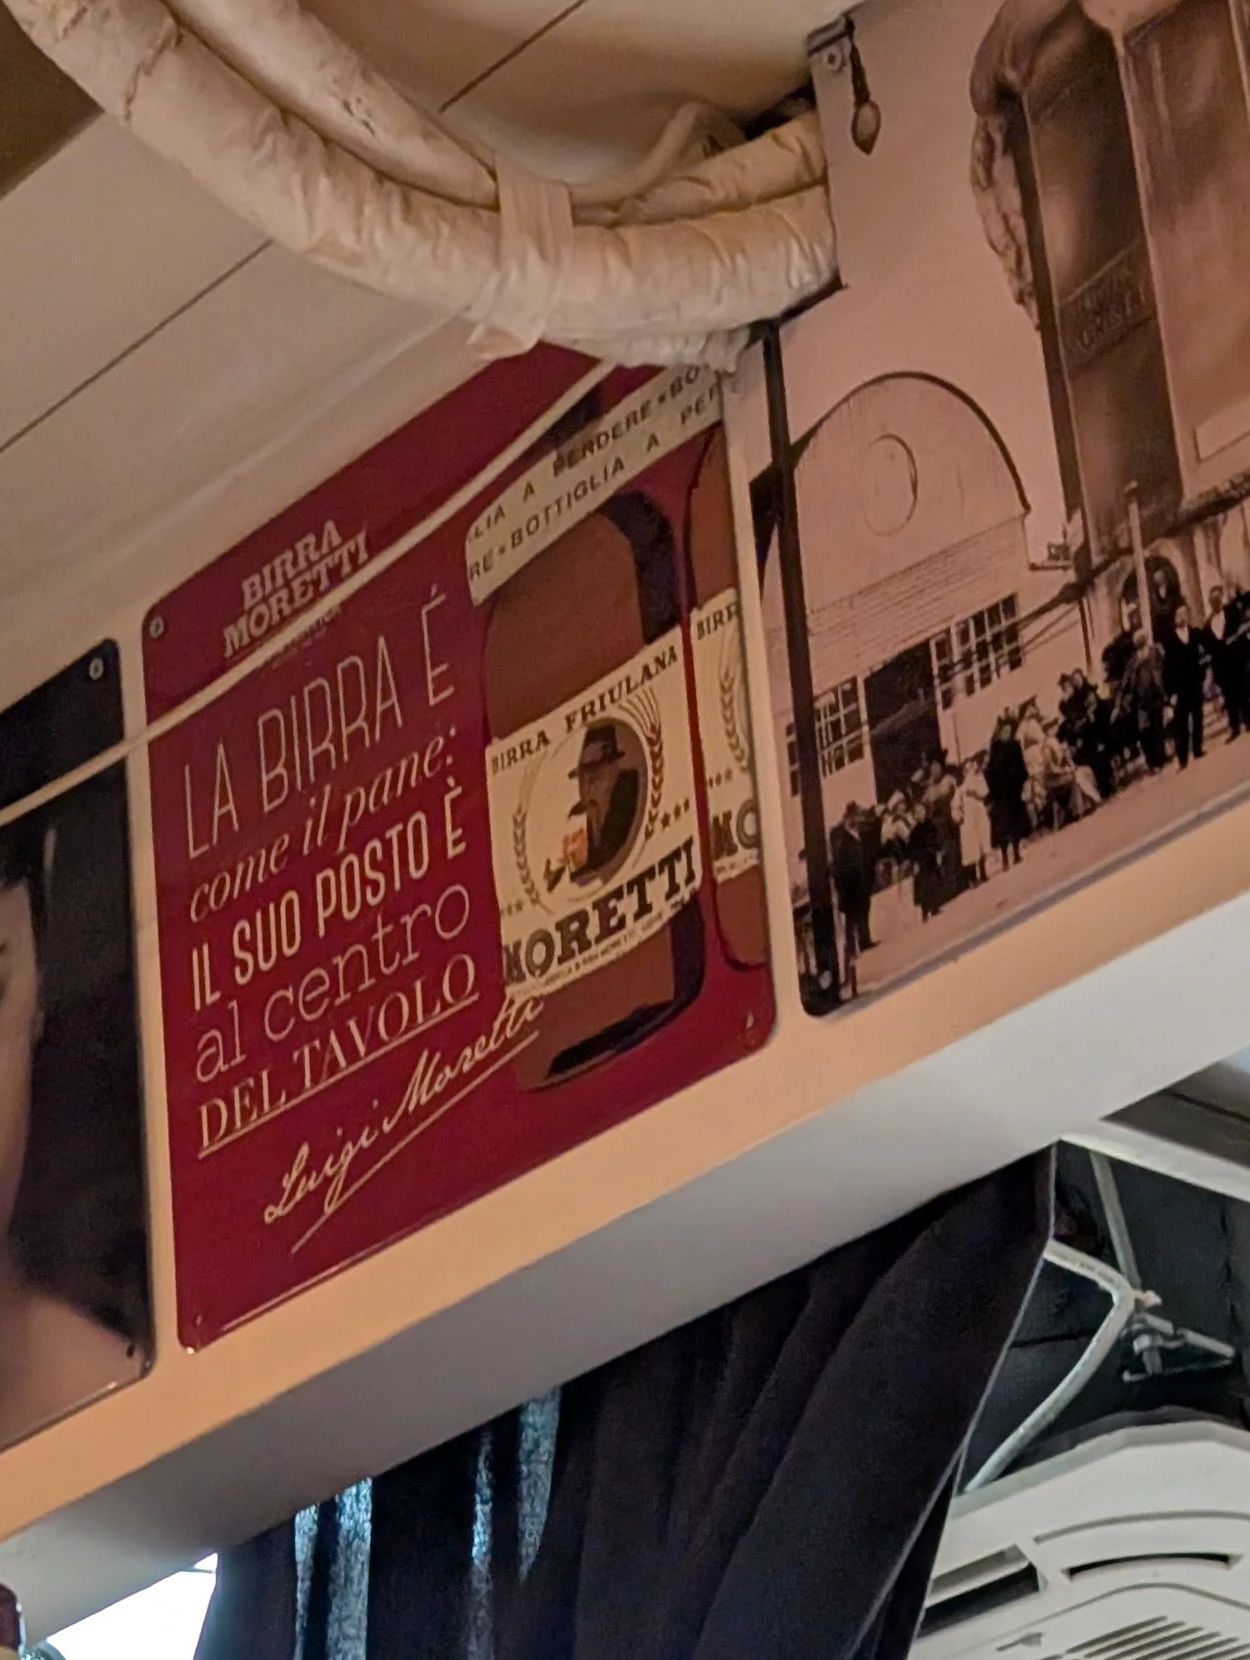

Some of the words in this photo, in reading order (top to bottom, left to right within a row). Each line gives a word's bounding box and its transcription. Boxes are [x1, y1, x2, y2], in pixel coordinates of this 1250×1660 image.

[510, 456, 626, 549] BOTTIGLIA
[646, 432, 660, 453] A
[523, 480, 537, 502] A
[553, 400, 651, 478] PERDERE
[670, 362, 709, 398] BO
[222, 528, 370, 659] MORETTI
[241, 519, 343, 610] BIRRA
[184, 741, 238, 858] LA
[257, 635, 403, 814] BIRRA
[491, 729, 550, 777] BIRRA
[564, 645, 679, 734] FRIULANA
[190, 833, 290, 922] come
[302, 784, 332, 856] il
[337, 726, 456, 855] pane:
[192, 943, 221, 1011] IL
[233, 890, 301, 985] SUO
[316, 811, 429, 938] POSTO
[444, 777, 467, 859] È
[195, 999, 246, 1083] al
[264, 884, 470, 1040] centro
[503, 836, 703, 985] MORETTI
[198, 1069, 287, 1147] DEL
[293, 954, 476, 1089] TAVOLO
[264, 1099, 379, 1224] Luigi
[382, 996, 544, 1132] Moretti
